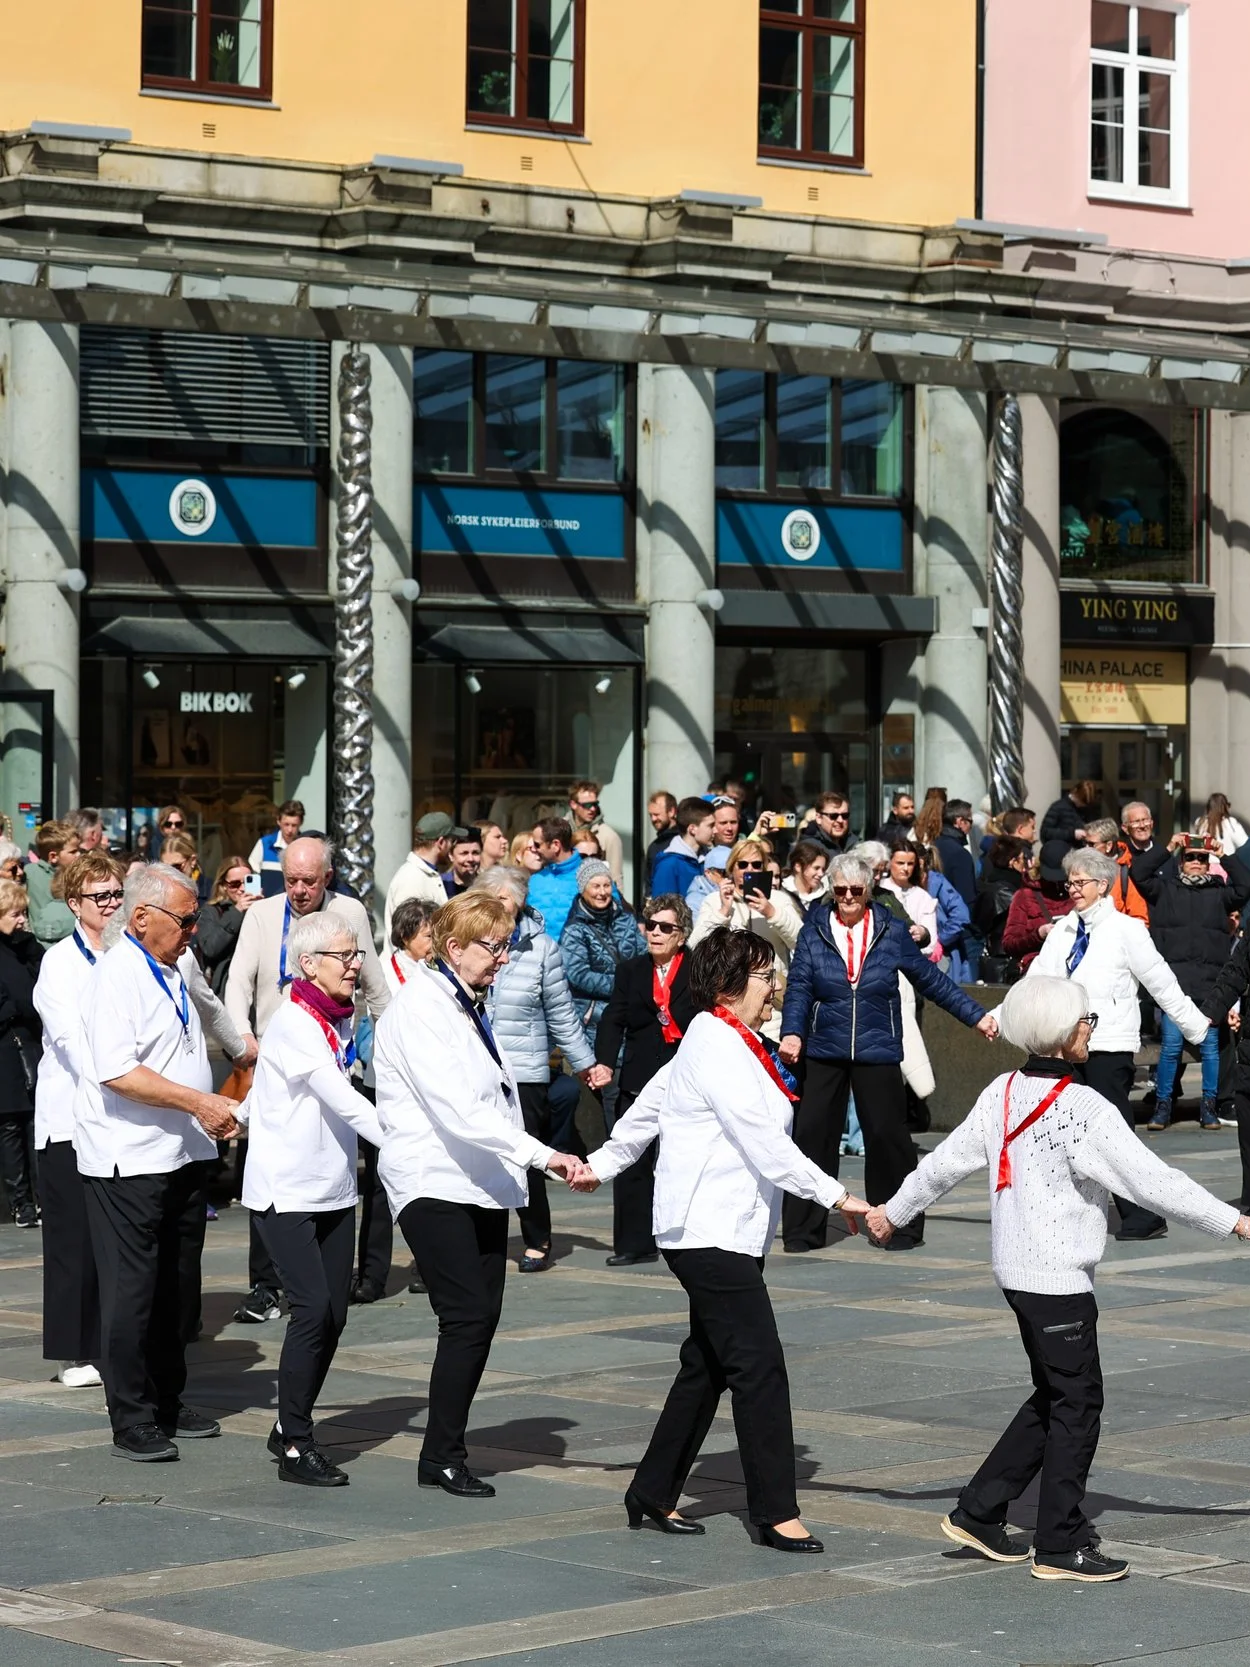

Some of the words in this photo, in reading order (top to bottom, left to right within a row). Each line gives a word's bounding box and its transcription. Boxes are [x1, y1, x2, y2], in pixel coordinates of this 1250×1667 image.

[447, 515, 479, 526] NORSK
[481, 516, 581, 531] SYKEPLEIERFORBUND
[1080, 598, 1127, 619] YING
[1132, 600, 1179, 621] YING
[1101, 661, 1164, 678] PALACE
[180, 692, 212, 713] BIK
[213, 692, 253, 713] BOK
